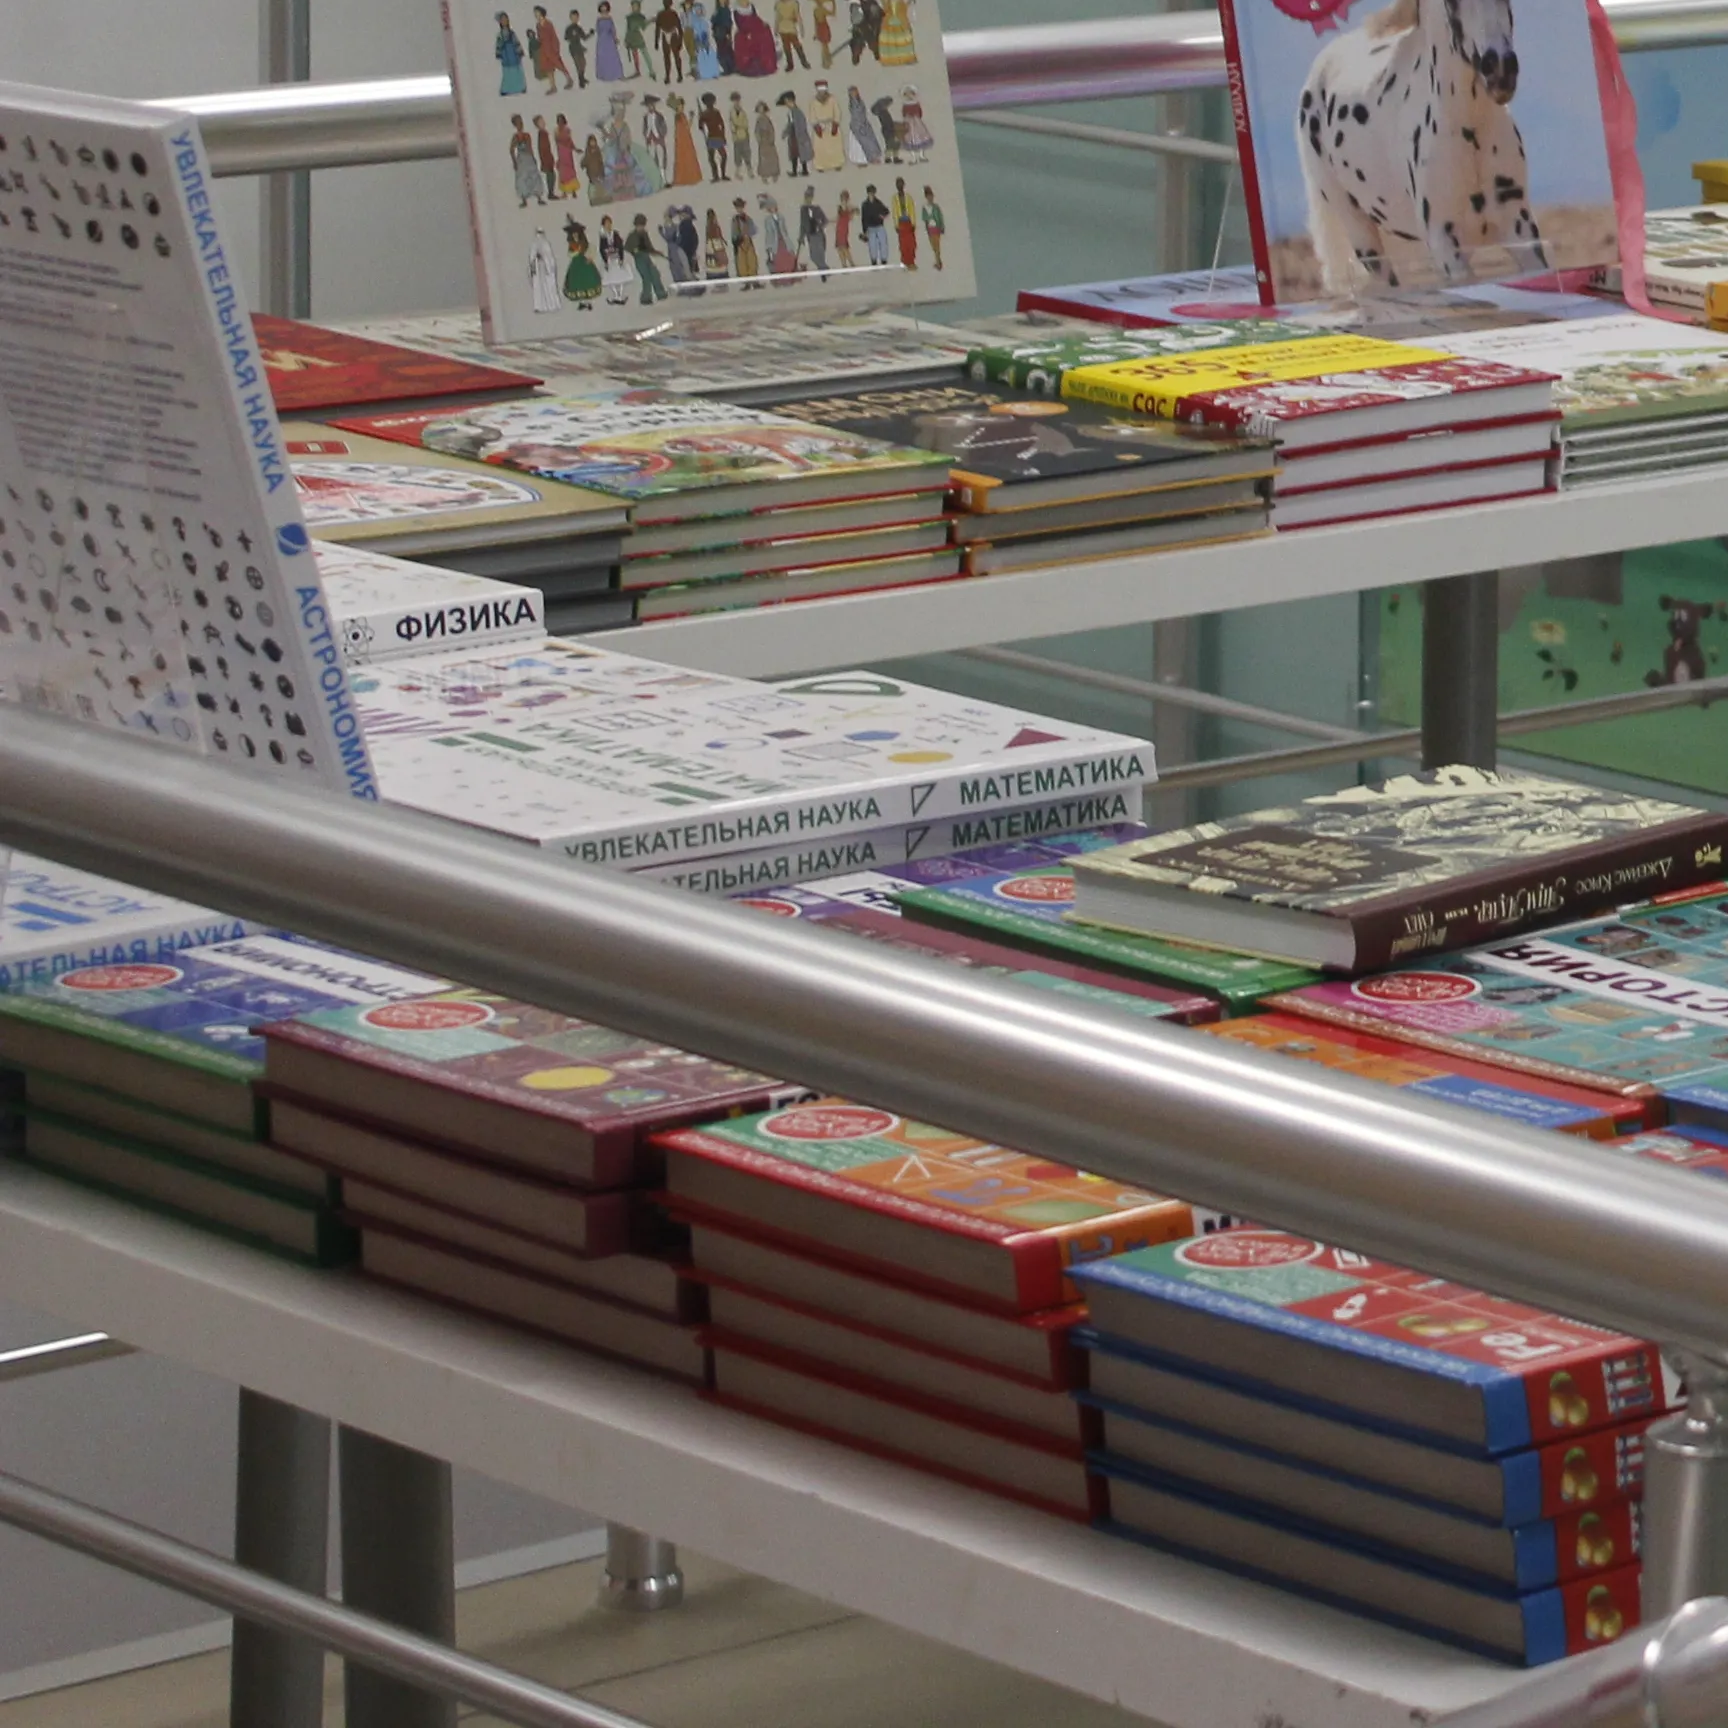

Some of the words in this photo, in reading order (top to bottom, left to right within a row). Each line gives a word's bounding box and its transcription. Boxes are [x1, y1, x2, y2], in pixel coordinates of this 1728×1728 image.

[169, 127, 259, 390] УВЛЕКАТЕЛЬНАЯ
[243, 390, 284, 495] НАУКА
[294, 582, 380, 803] АСТРОНОМИЯ
[394, 597, 538, 642] ФИЗИКА
[564, 808, 791, 863] УВЛЕКАТЕЛЬНАЯ
[797, 794, 883, 832] НАУКА
[958, 752, 1145, 807] МАТЕМАТИКА
[796, 839, 878, 875] НАУКА
[951, 792, 1129, 850] МАТЕМАТИКА
[156, 919, 249, 956] НАУКА
